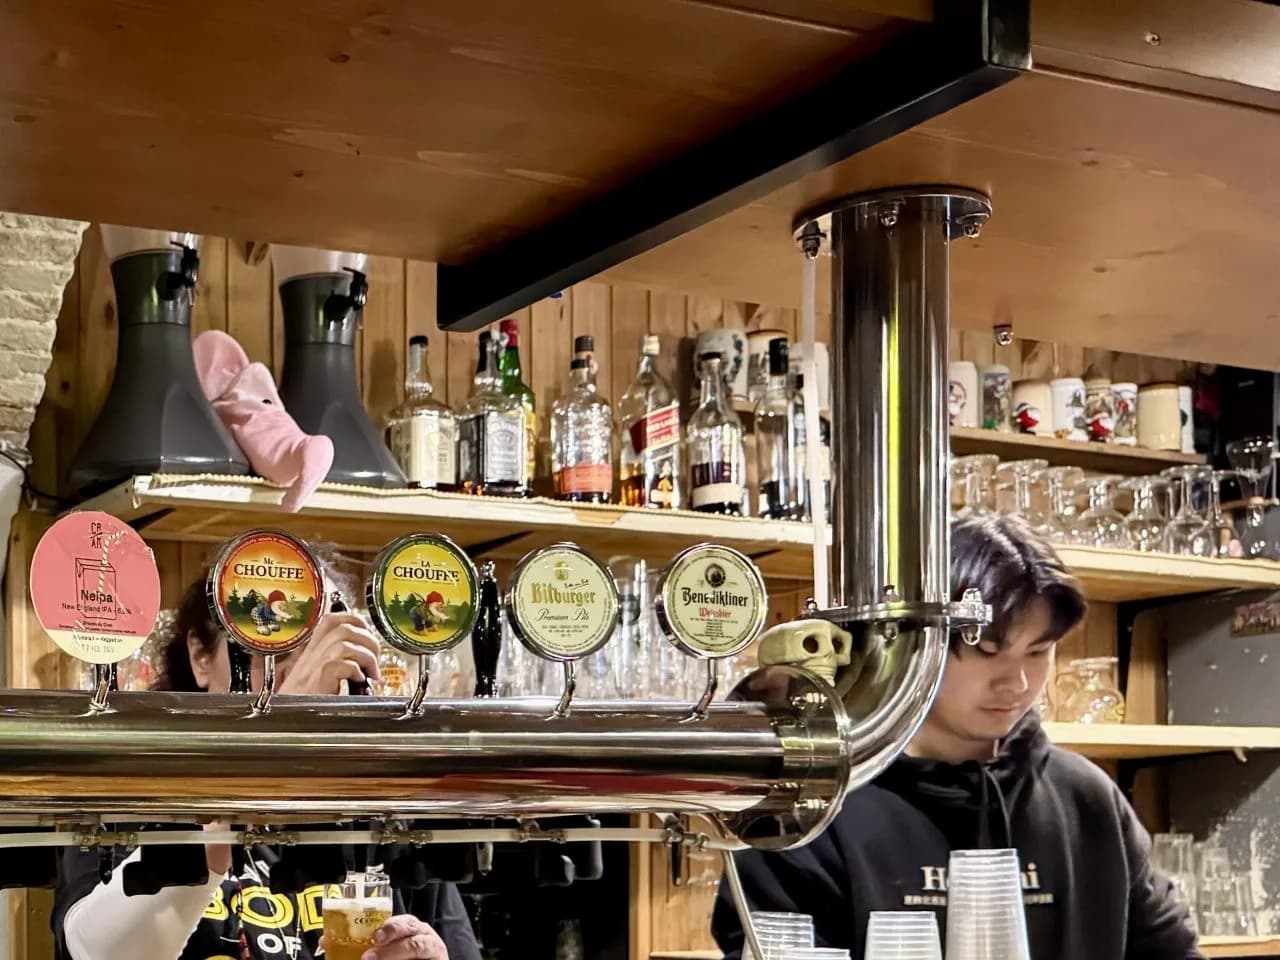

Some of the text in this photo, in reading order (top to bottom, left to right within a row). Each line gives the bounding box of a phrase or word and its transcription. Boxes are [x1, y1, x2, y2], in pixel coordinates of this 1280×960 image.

[263, 557, 274, 566] Mc
[421, 560, 431, 568] LA
[233, 563, 304, 580] CHOUFFE
[393, 566, 460, 583] CHOUFFE
[531, 582, 596, 607] Bitburger
[681, 586, 749, 607] Benediktiner
[536, 608, 590, 621] Premium Pils
[256, 933, 303, 955] OF
